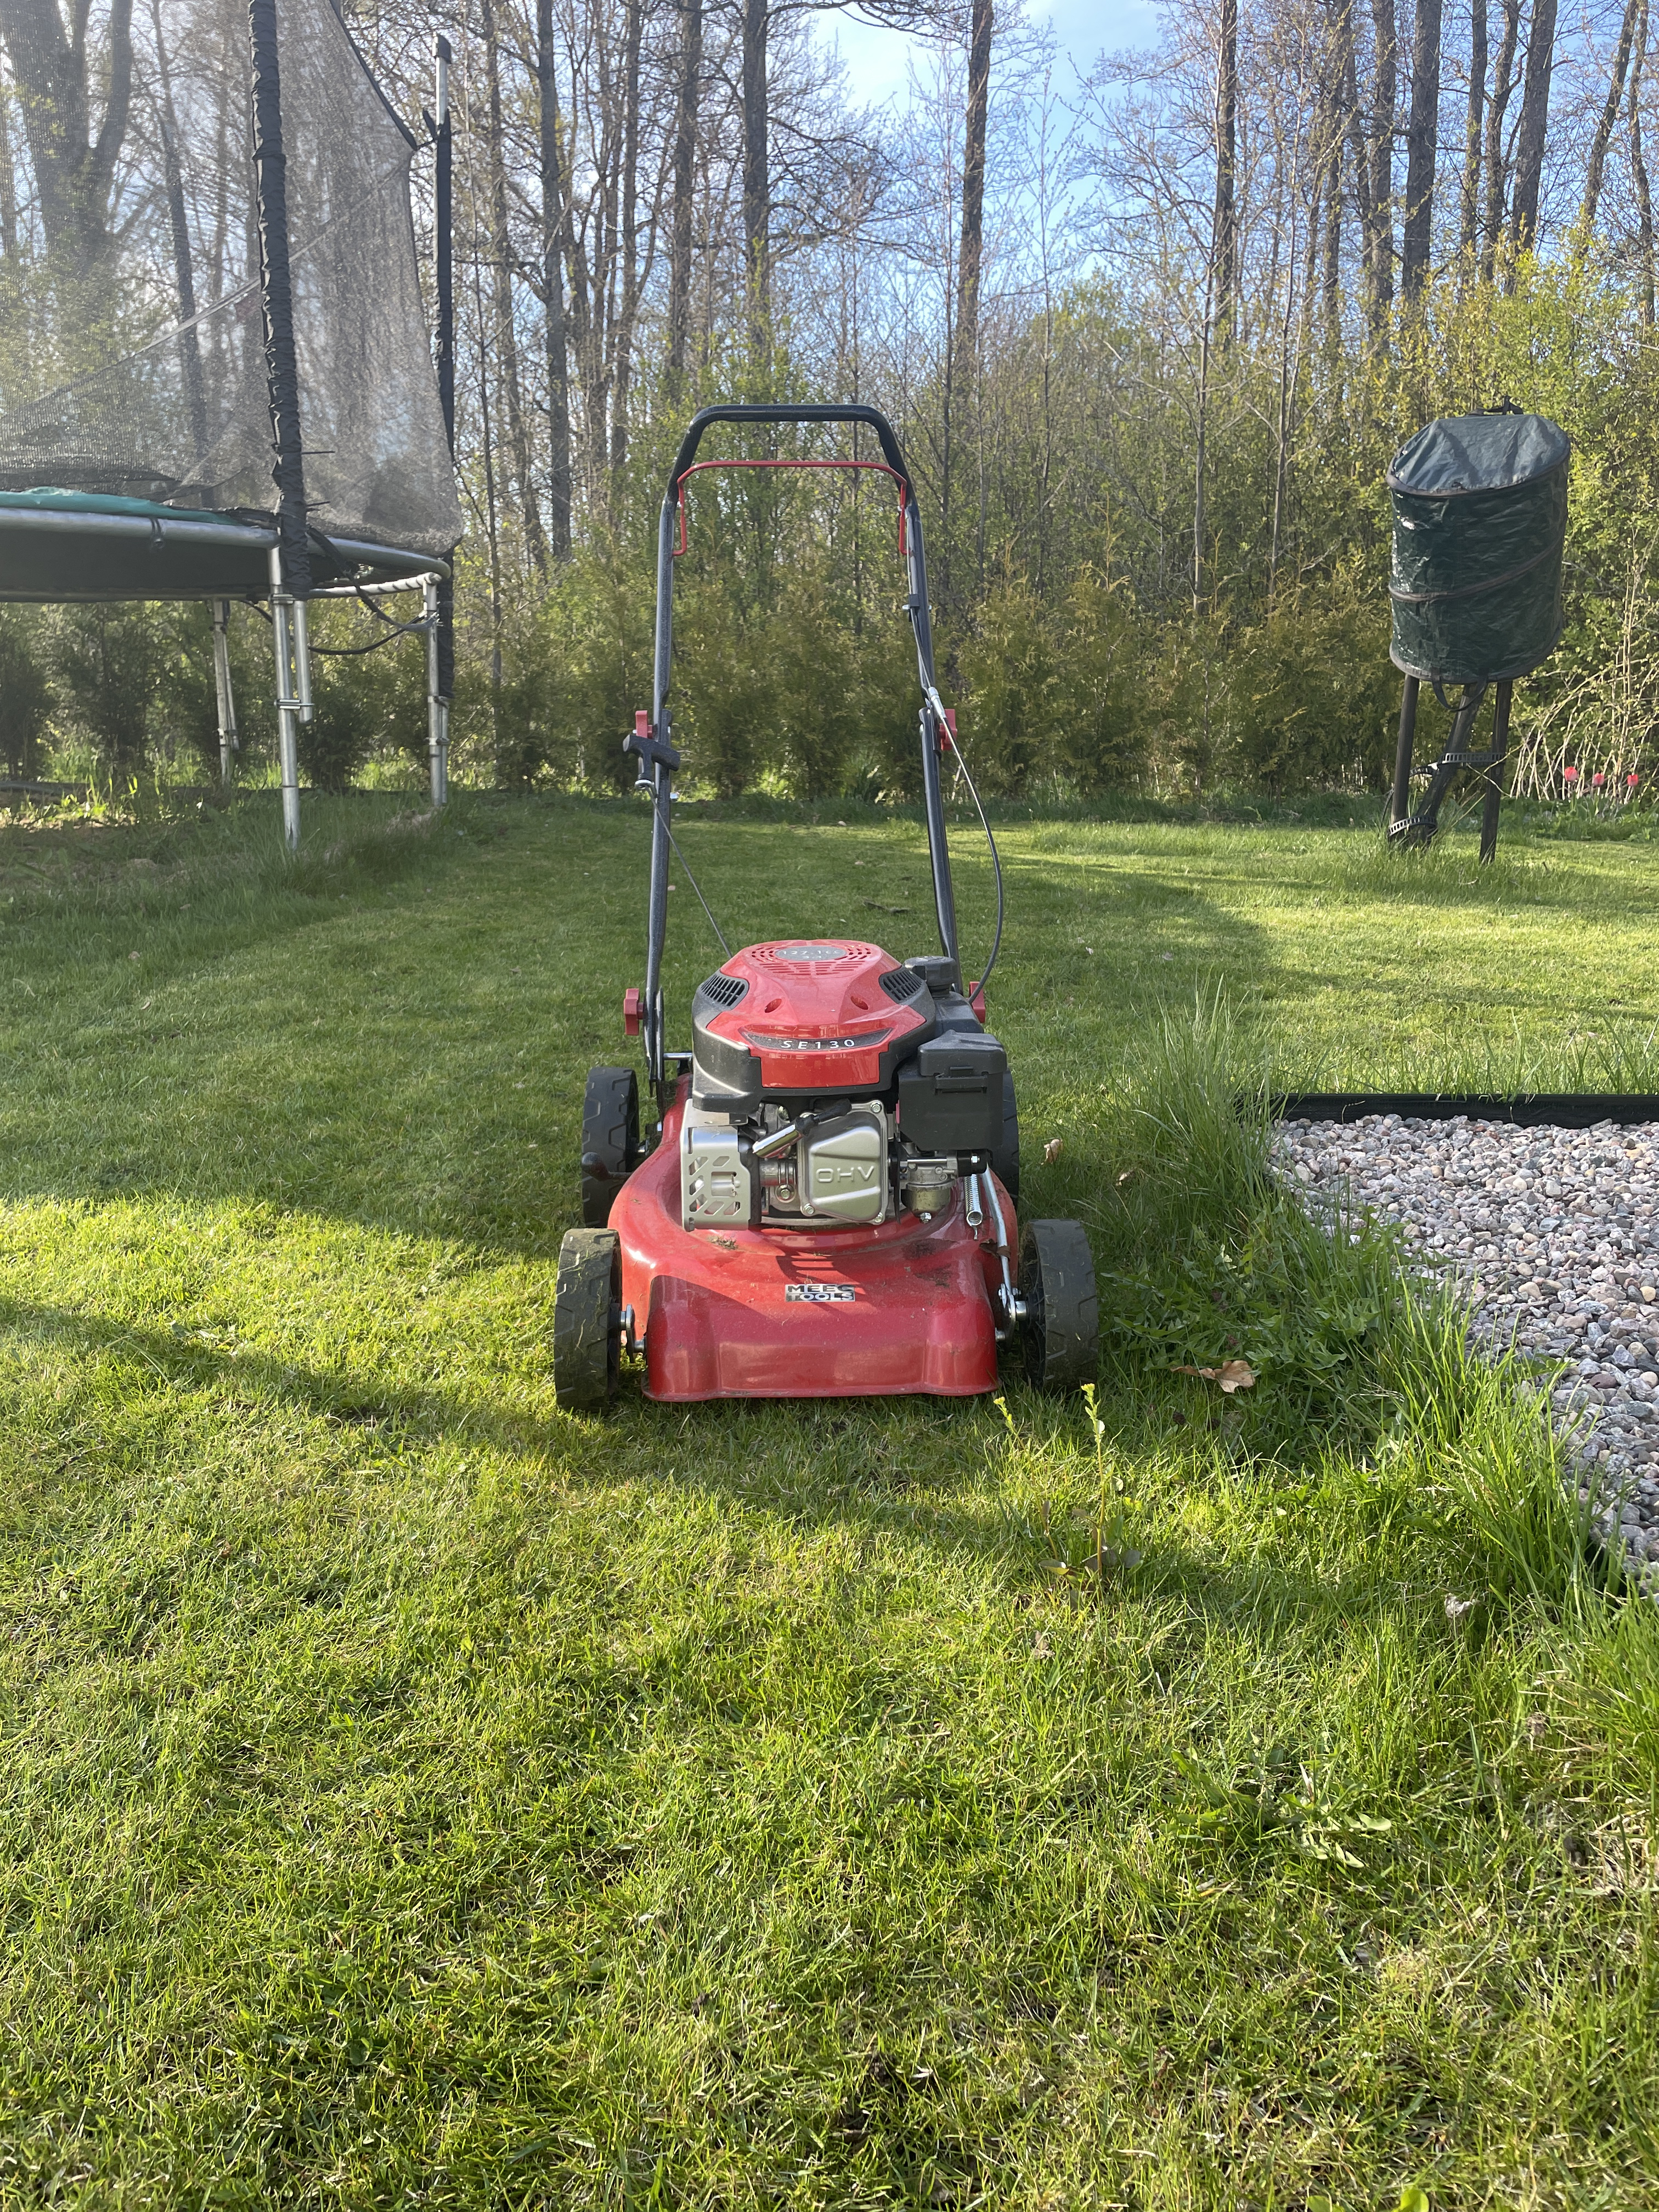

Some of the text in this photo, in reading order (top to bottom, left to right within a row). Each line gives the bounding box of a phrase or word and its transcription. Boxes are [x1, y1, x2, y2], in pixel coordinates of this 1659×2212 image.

[781, 1039, 855, 1049] SE130
[816, 1165, 874, 1183] OHV
[787, 1293, 854, 1301] TOOLS
